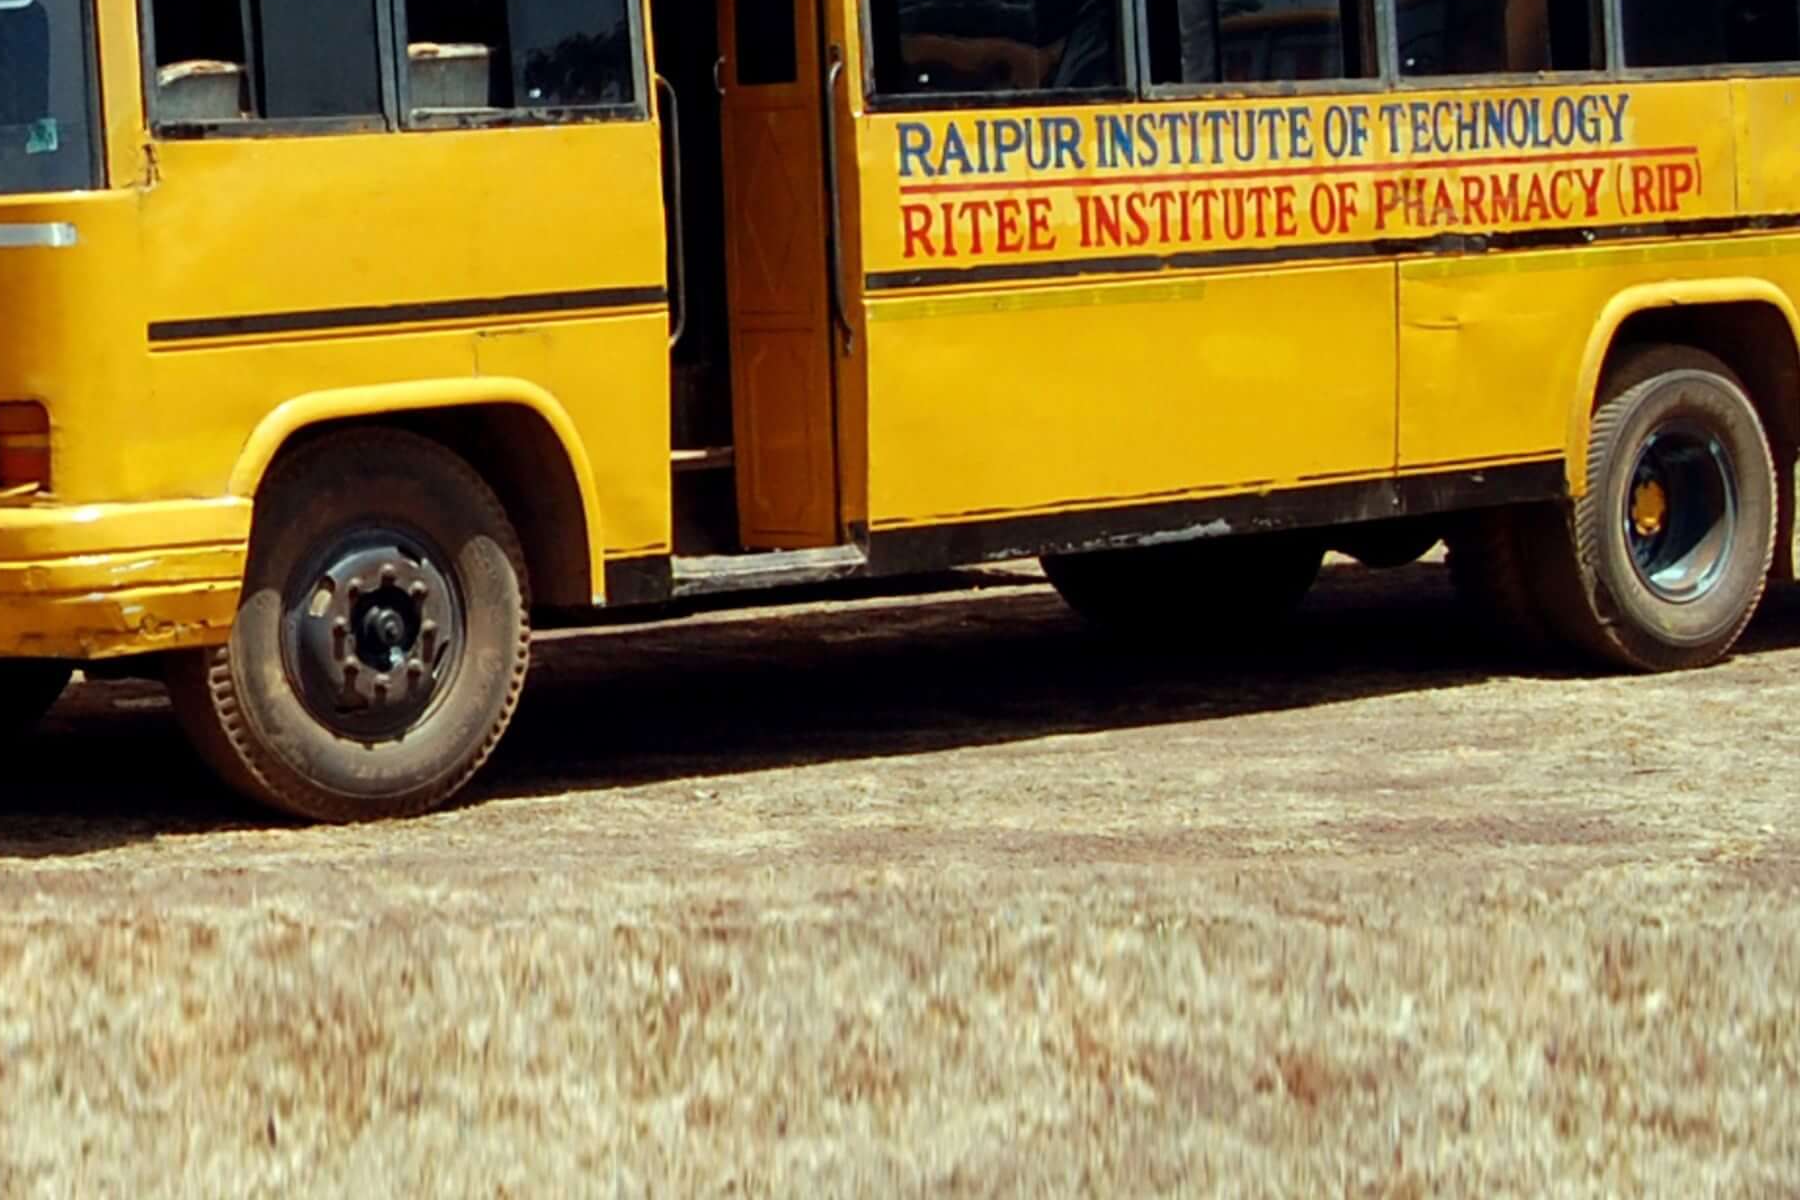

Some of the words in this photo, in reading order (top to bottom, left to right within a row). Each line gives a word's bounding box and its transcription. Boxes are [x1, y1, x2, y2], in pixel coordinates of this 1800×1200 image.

[896, 116, 1084, 177] RAIPUR
[1095, 105, 1313, 168] INSTITUTE
[1323, 105, 1369, 157] OF
[1380, 93, 1631, 154] TECHNOLOGY
[900, 198, 1056, 259] RITEE
[1078, 181, 1298, 249] INSTITUTE
[1309, 178, 1358, 235] OF
[1374, 166, 1606, 230] PHARMACY
[1616, 157, 1703, 217] (RIP)
